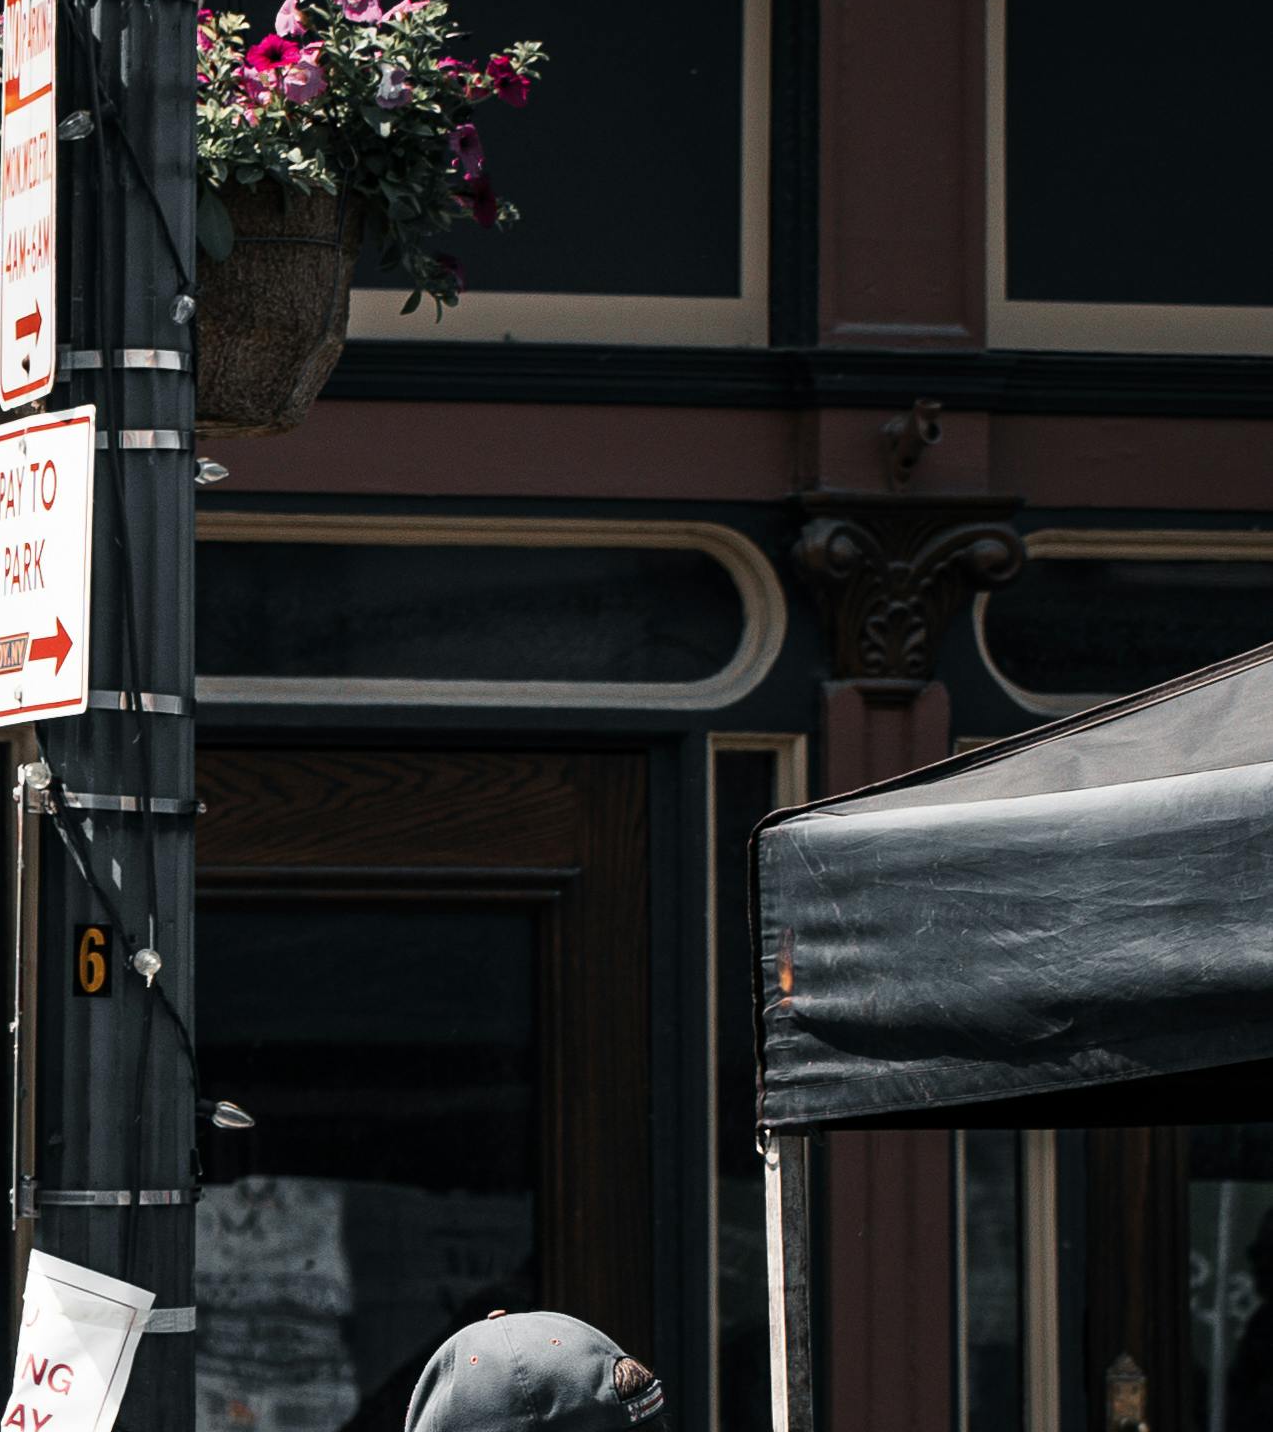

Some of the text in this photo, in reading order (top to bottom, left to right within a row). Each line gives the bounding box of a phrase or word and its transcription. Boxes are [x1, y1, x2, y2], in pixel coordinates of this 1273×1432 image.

[6, 1, 21, 80] NO
[29, 460, 56, 511] TO
[3, 538, 45, 596] PARK
[78, 925, 108, 995] 6
